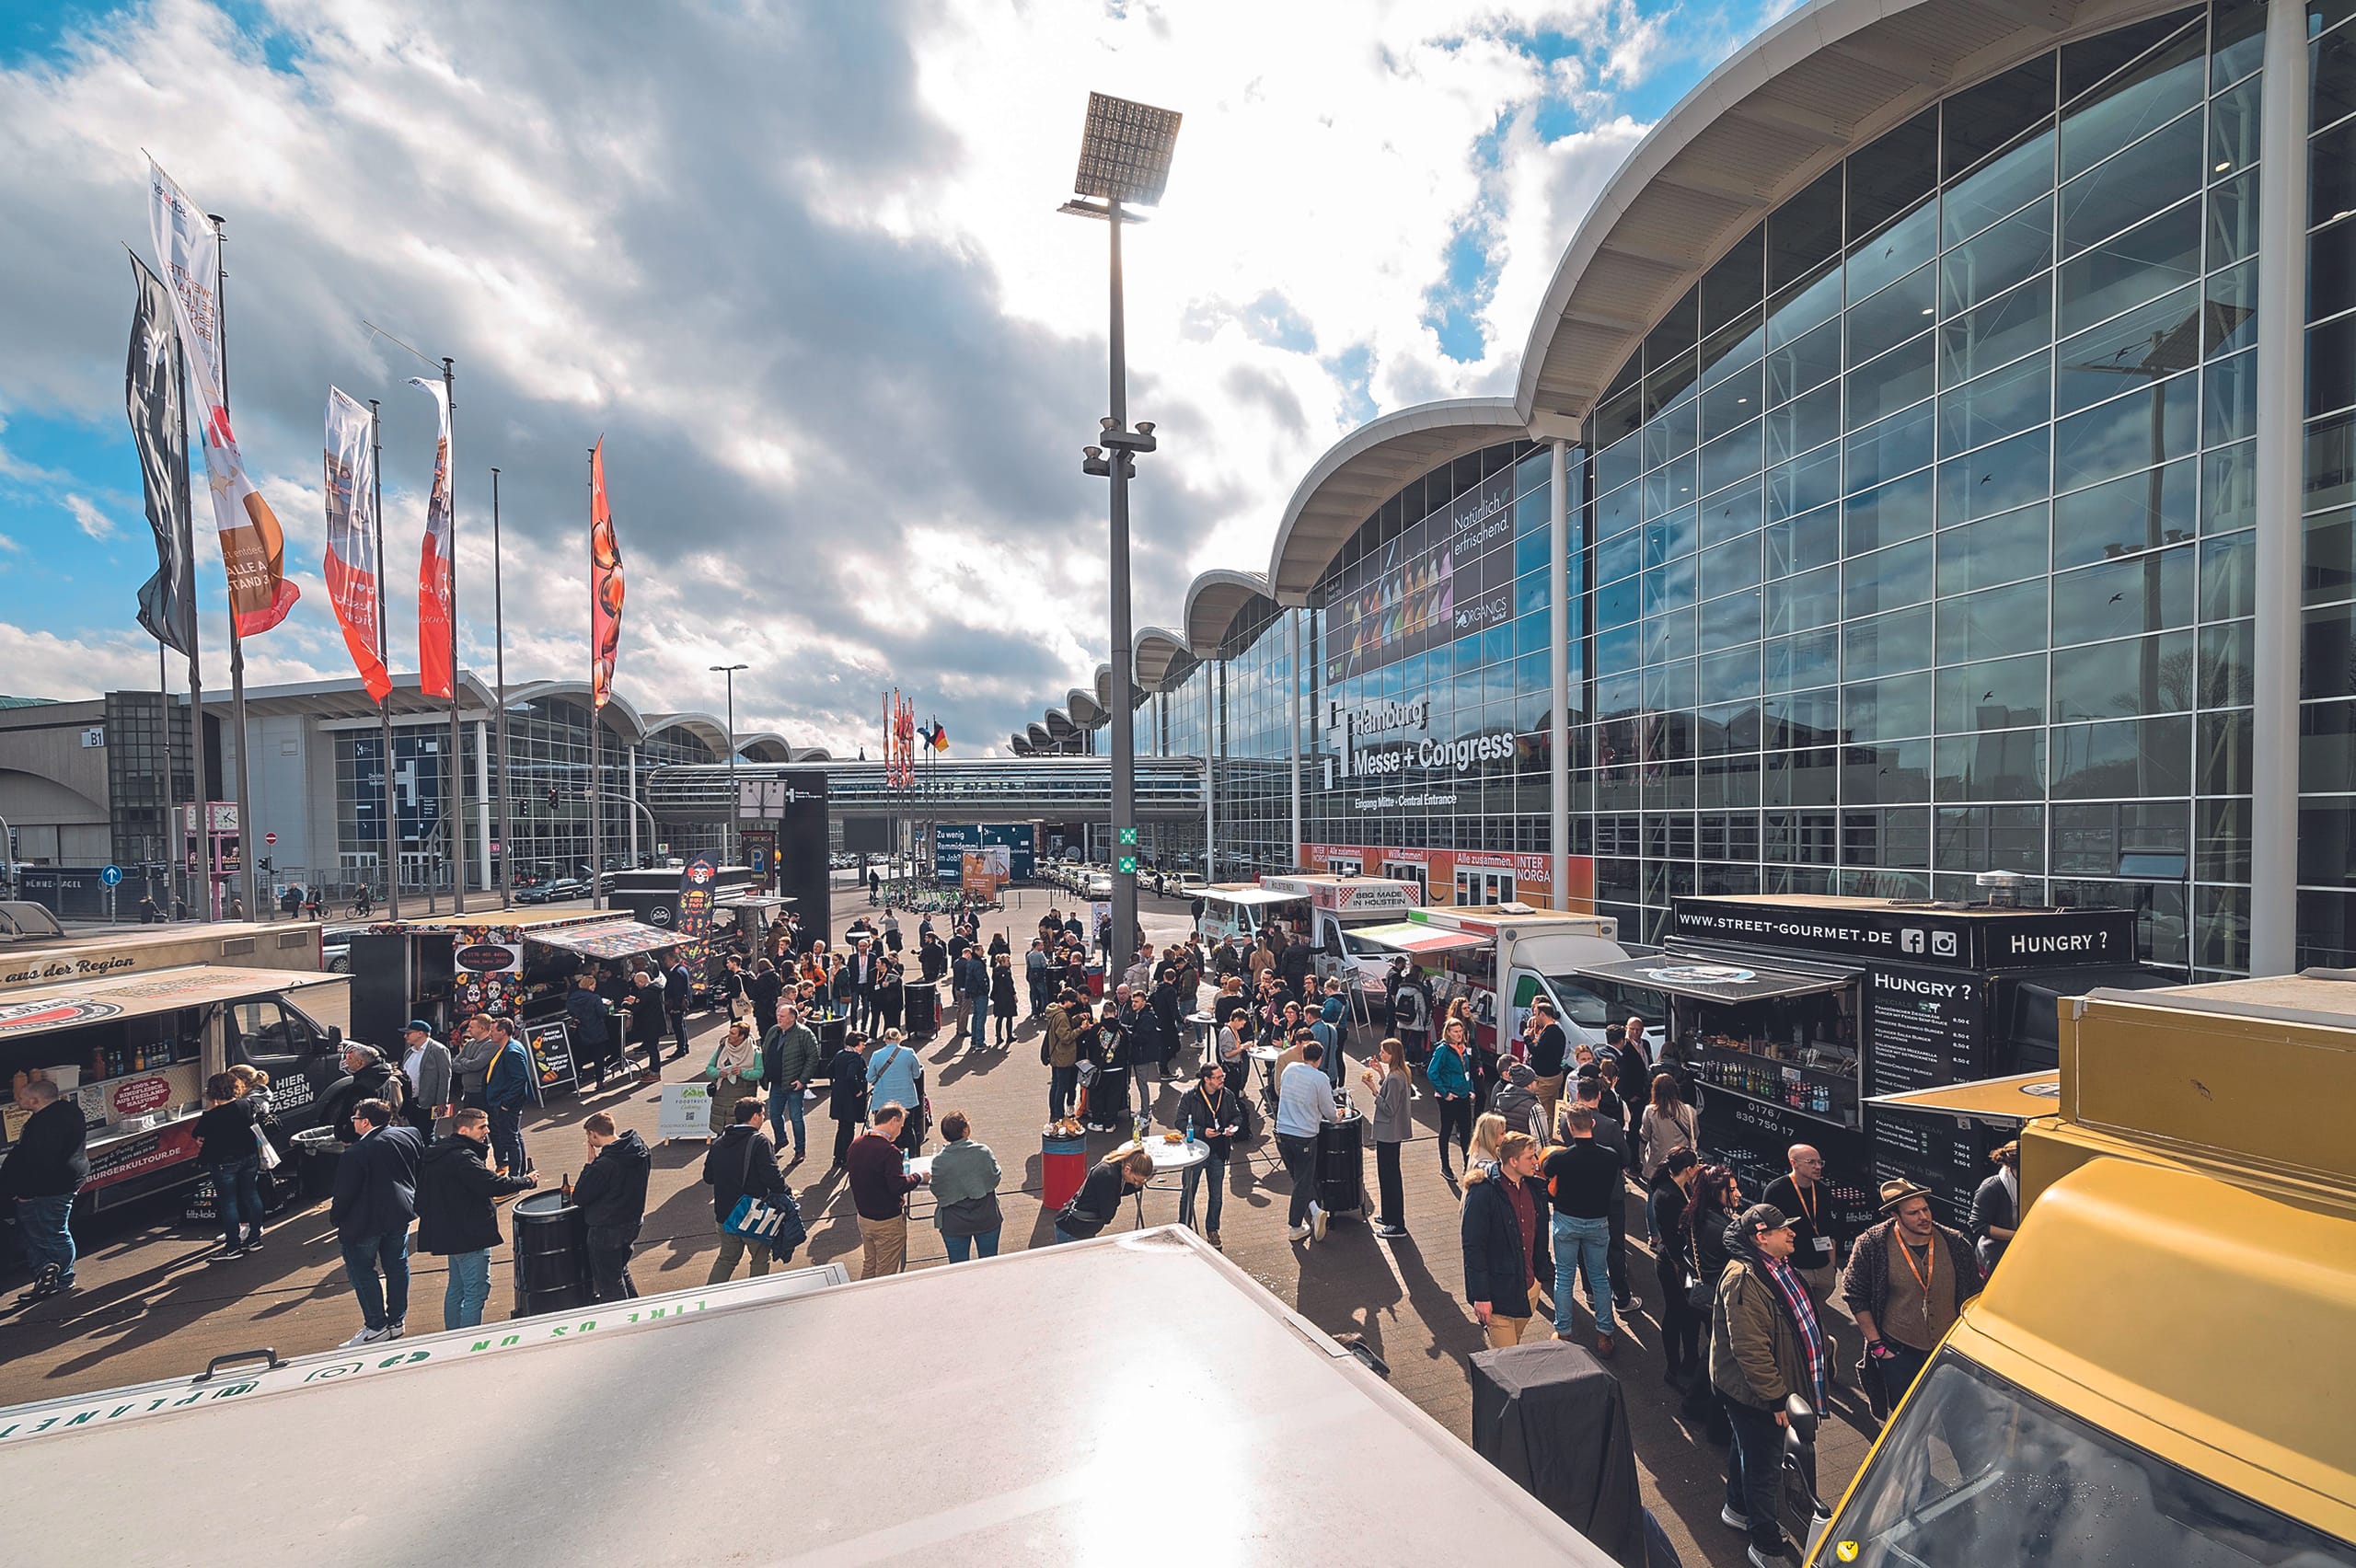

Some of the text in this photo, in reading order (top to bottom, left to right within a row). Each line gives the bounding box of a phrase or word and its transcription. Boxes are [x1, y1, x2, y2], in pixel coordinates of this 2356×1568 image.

[1454, 492, 1500, 533] Natürlich
[1454, 511, 1509, 556] erfrischend.
[234, 546, 265, 558] entdec
[226, 561, 257, 577] ALLE
[1353, 702, 1426, 734] Hamburg
[91, 732, 102, 746] B1
[1354, 732, 1514, 777] Messe + Congress
[1355, 793, 1457, 811] Eingang Mitte Central Entrance
[937, 831, 964, 840] Zu wenig
[937, 854, 961, 862] im Job?
[1388, 848, 1424, 861] Willkommen!
[1457, 853, 1514, 868] Alle zusammen.
[1517, 856, 1543, 868] INTER
[1517, 870, 1552, 883] NORGA
[1352, 898, 1406, 907] IN HOLSTEIN
[1356, 891, 1403, 900] BBQ MADE
[2099, 931, 2108, 949] ?
[5, 956, 135, 983] aus der Region
[1962, 985, 1971, 1000] ?
[133, 1082, 149, 1090] 100%
[275, 1073, 305, 1091] HIER
[116, 1089, 167, 1105] AUS FREILAND-
[119, 1084, 163, 1099] RINDFLEISCH
[271, 1082, 310, 1103] ESSEN
[126, 1095, 159, 1107] HALTUNG
[1748, 1102, 1774, 1118] 0176
[1736, 1111, 1795, 1137] 830 750 17
[186, 1209, 216, 1219] fritz-kola
[1846, 1210, 1873, 1222] fritz-kola
[627, 1300, 707, 1324] LIKE
[549, 1320, 597, 1339] US
